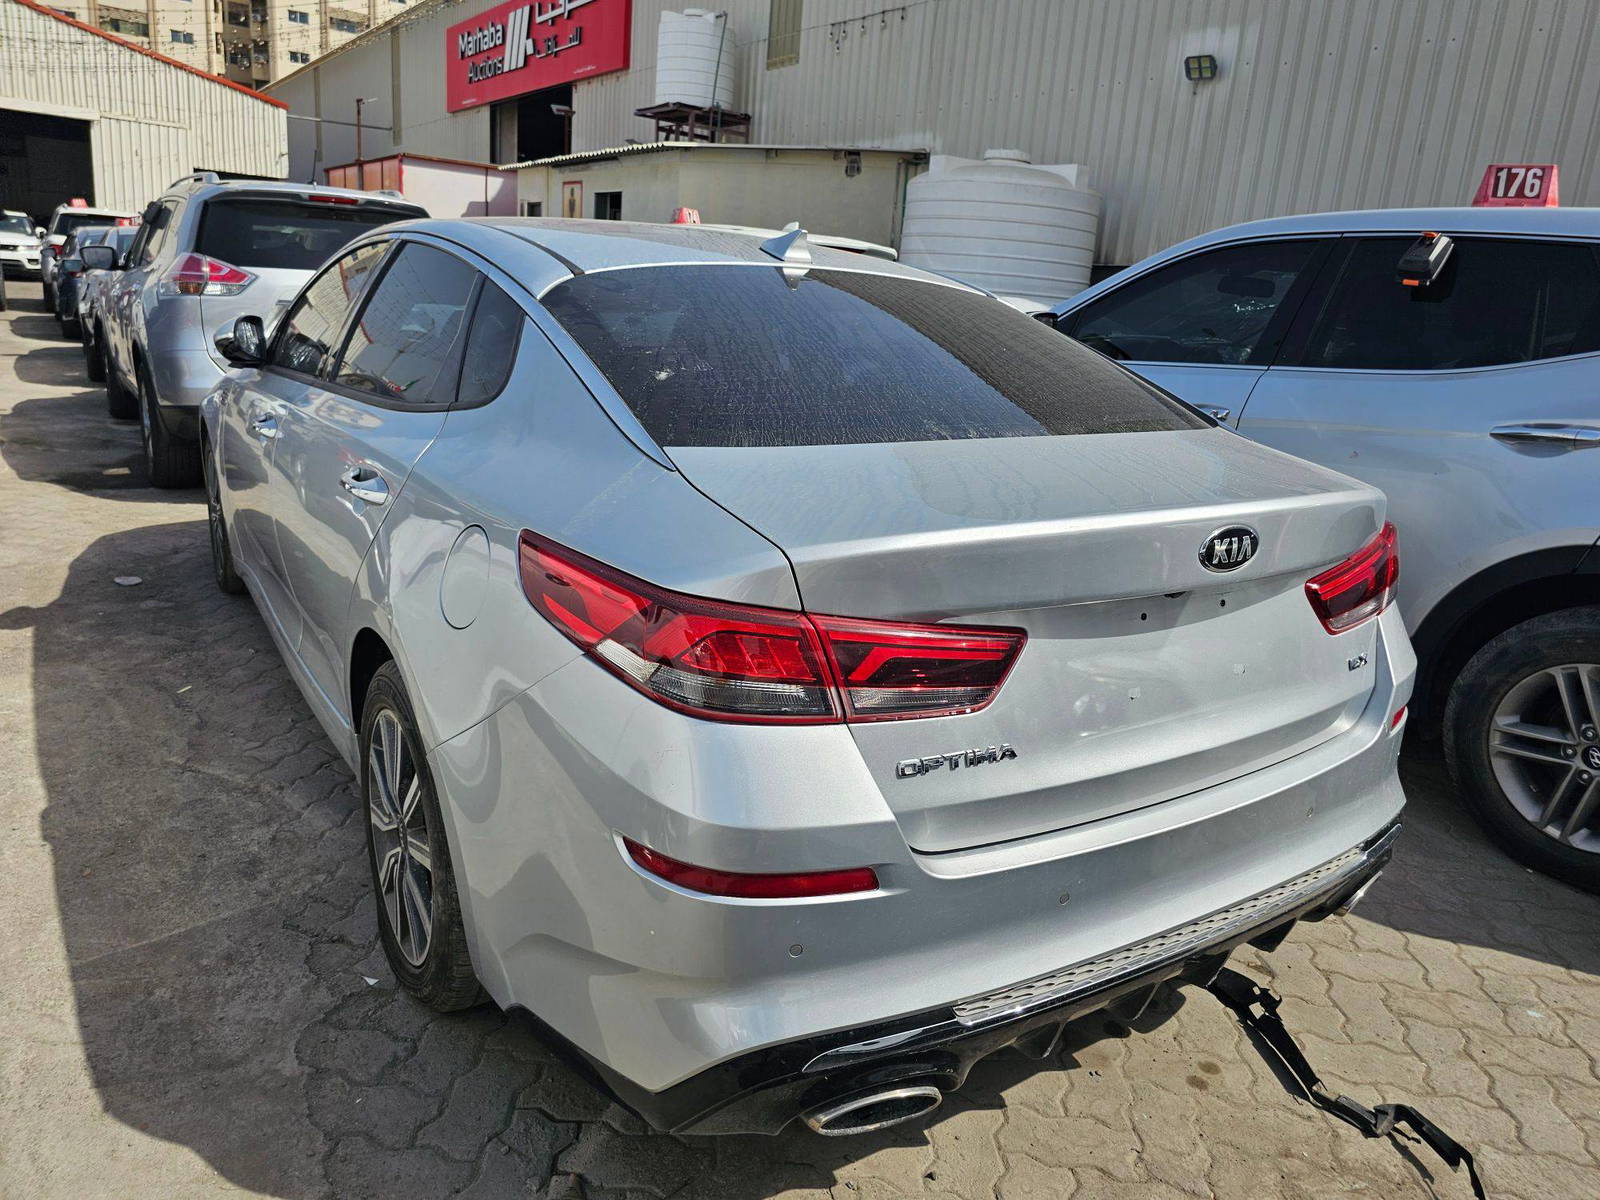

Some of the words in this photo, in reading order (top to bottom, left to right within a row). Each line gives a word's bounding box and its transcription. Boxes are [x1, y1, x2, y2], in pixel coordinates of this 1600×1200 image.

[459, 22, 504, 58] Marhaba
[468, 55, 505, 83] Auctions
[1497, 168, 1543, 198] 176
[1212, 535, 1253, 564] KIA
[896, 743, 1018, 779] OPTIMA
